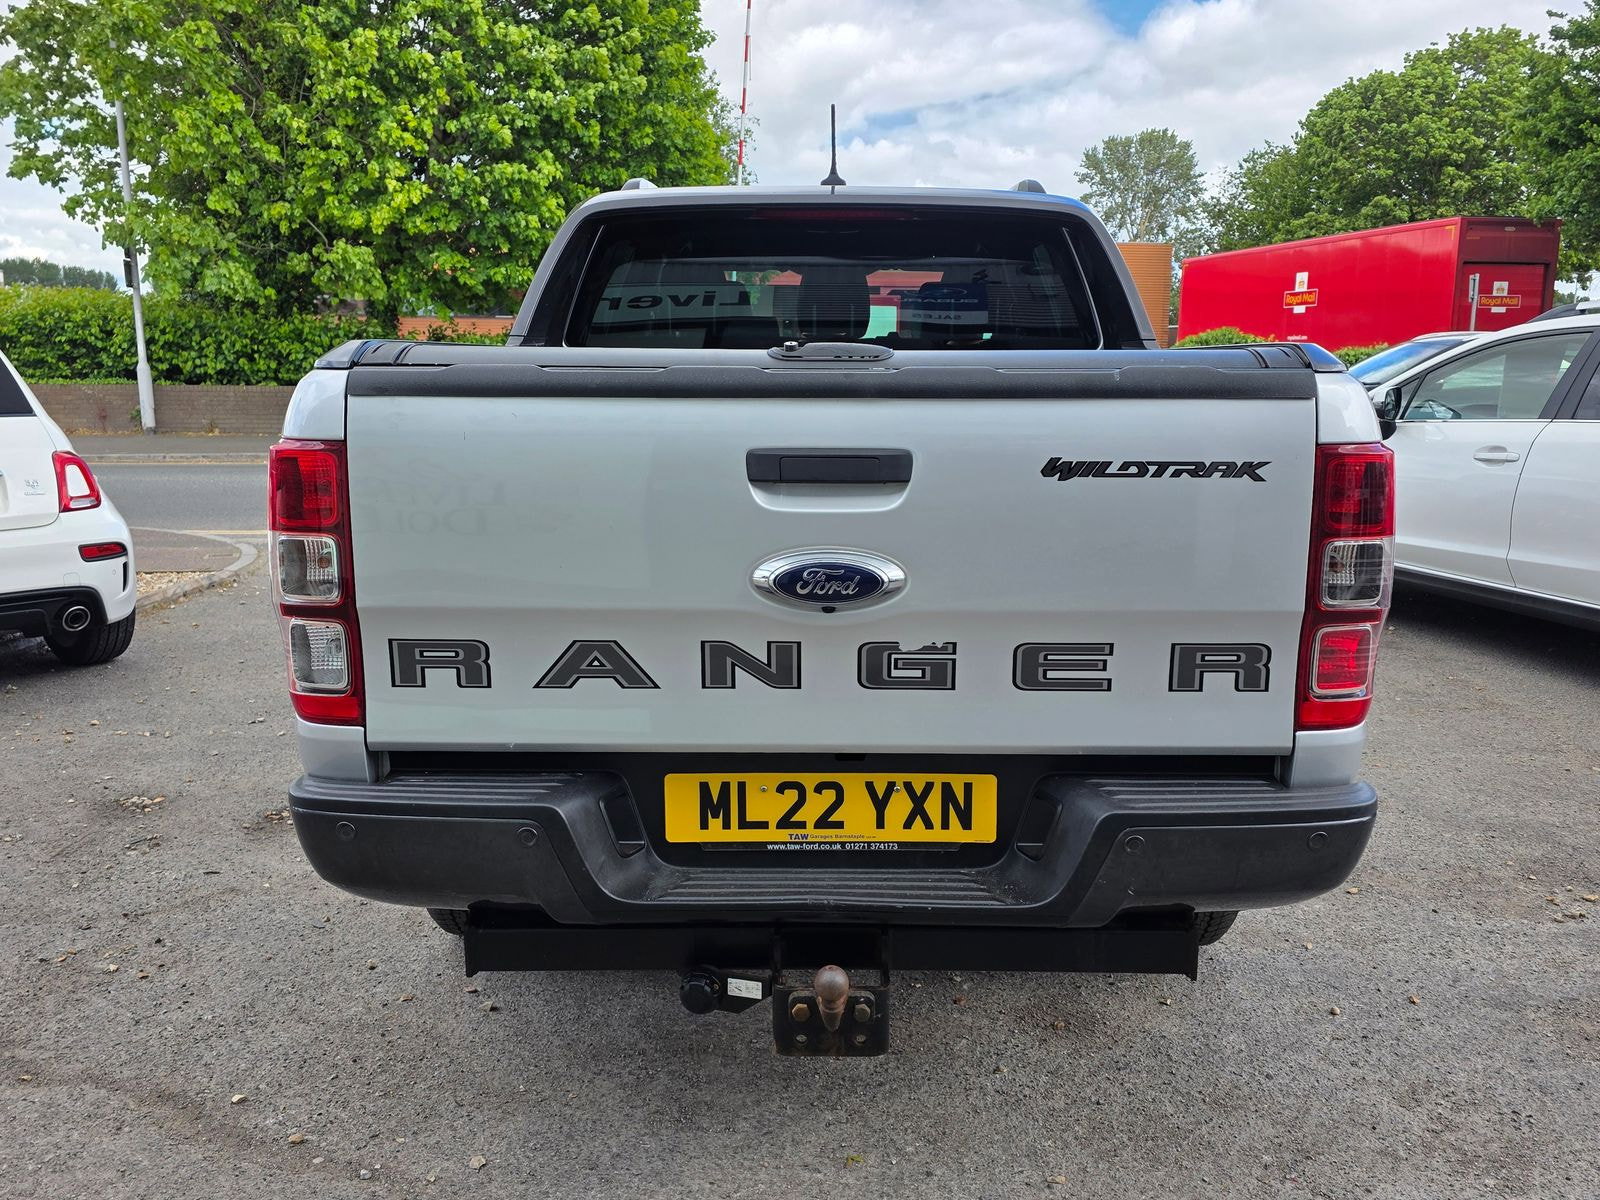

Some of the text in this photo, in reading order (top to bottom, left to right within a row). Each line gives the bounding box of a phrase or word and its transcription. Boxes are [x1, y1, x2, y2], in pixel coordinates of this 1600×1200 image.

[1286, 292, 1316, 305] Royal Mail
[1480, 296, 1519, 306] Royal Mail
[1040, 457, 1272, 481] WILDTRAK
[796, 568, 860, 595] Ford
[388, 638, 1272, 692] RANGER
[699, 781, 973, 831] ML22 YXN
[767, 842, 841, 850] www.taw-ford.co.uk
[788, 833, 809, 841] TAW
